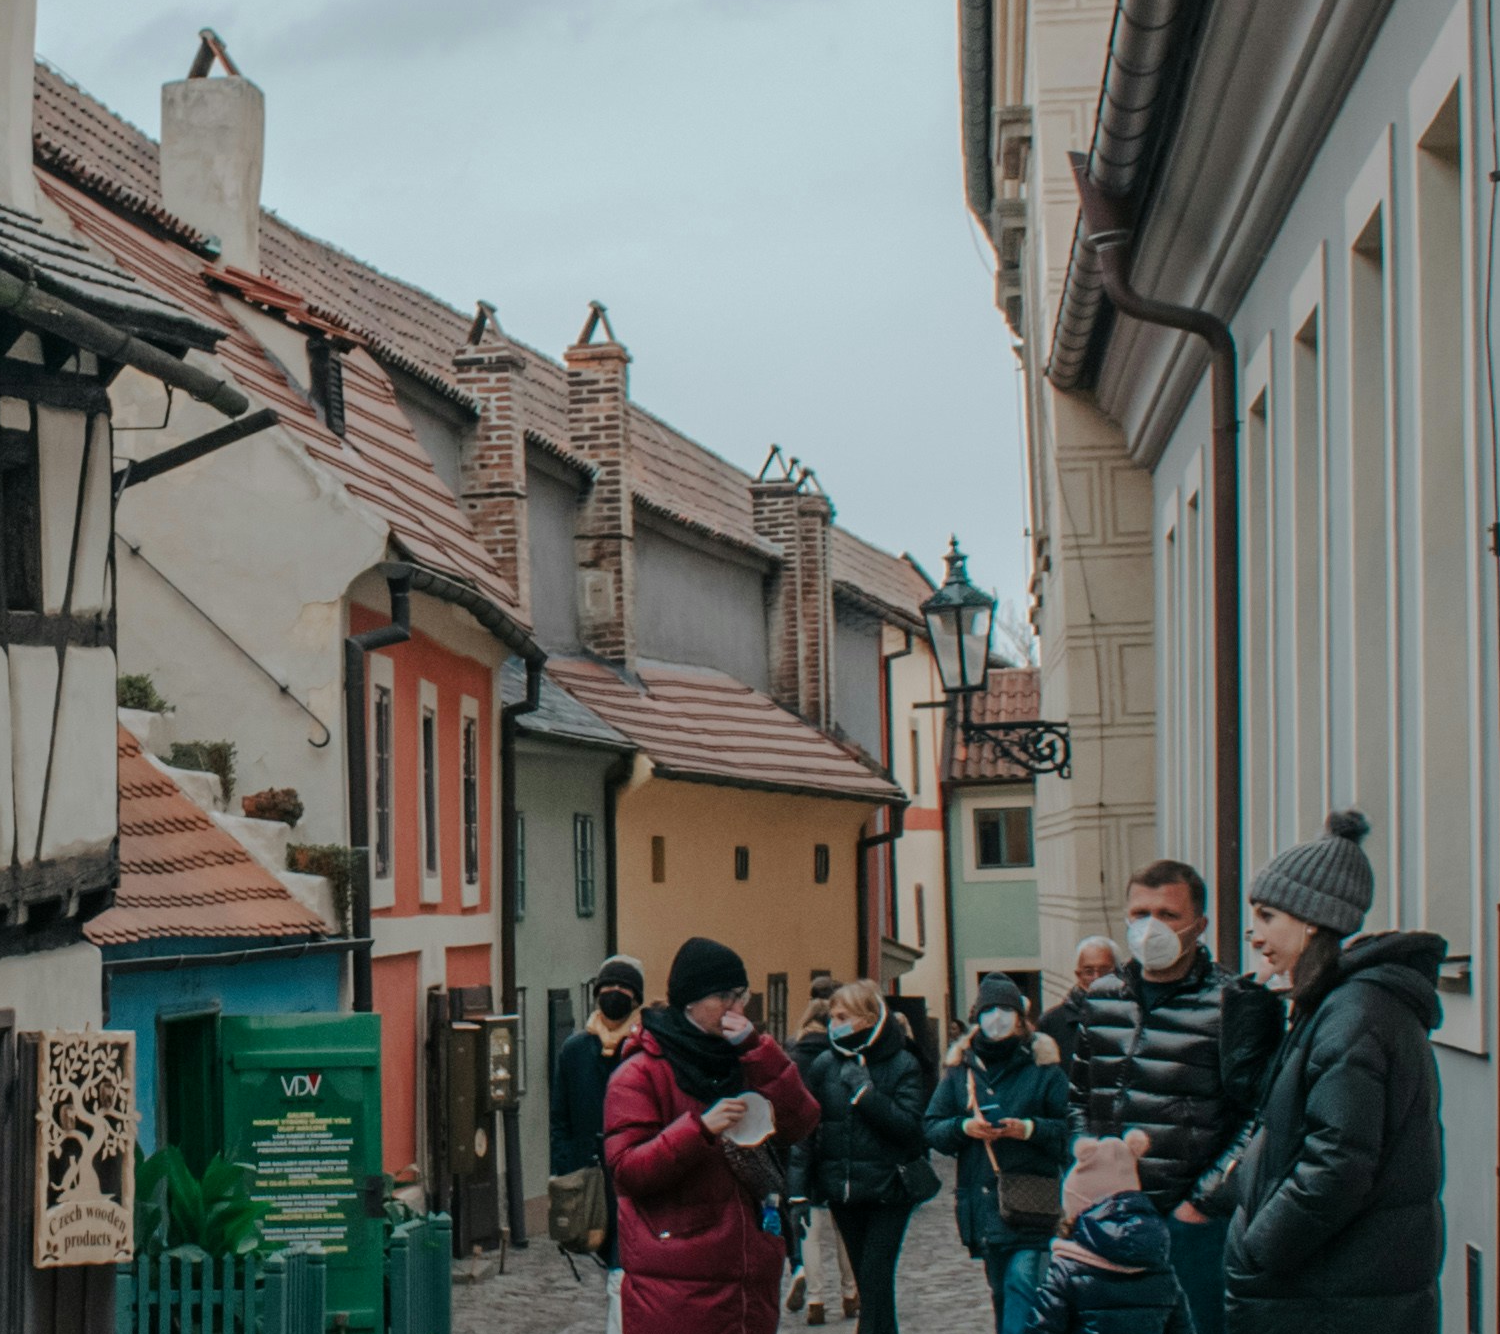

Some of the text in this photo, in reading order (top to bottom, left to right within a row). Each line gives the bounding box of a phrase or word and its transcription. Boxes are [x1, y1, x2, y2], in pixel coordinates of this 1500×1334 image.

[280, 1073, 322, 1096] VDV
[49, 1204, 126, 1237] Czech wooden
[64, 1230, 111, 1255] products
